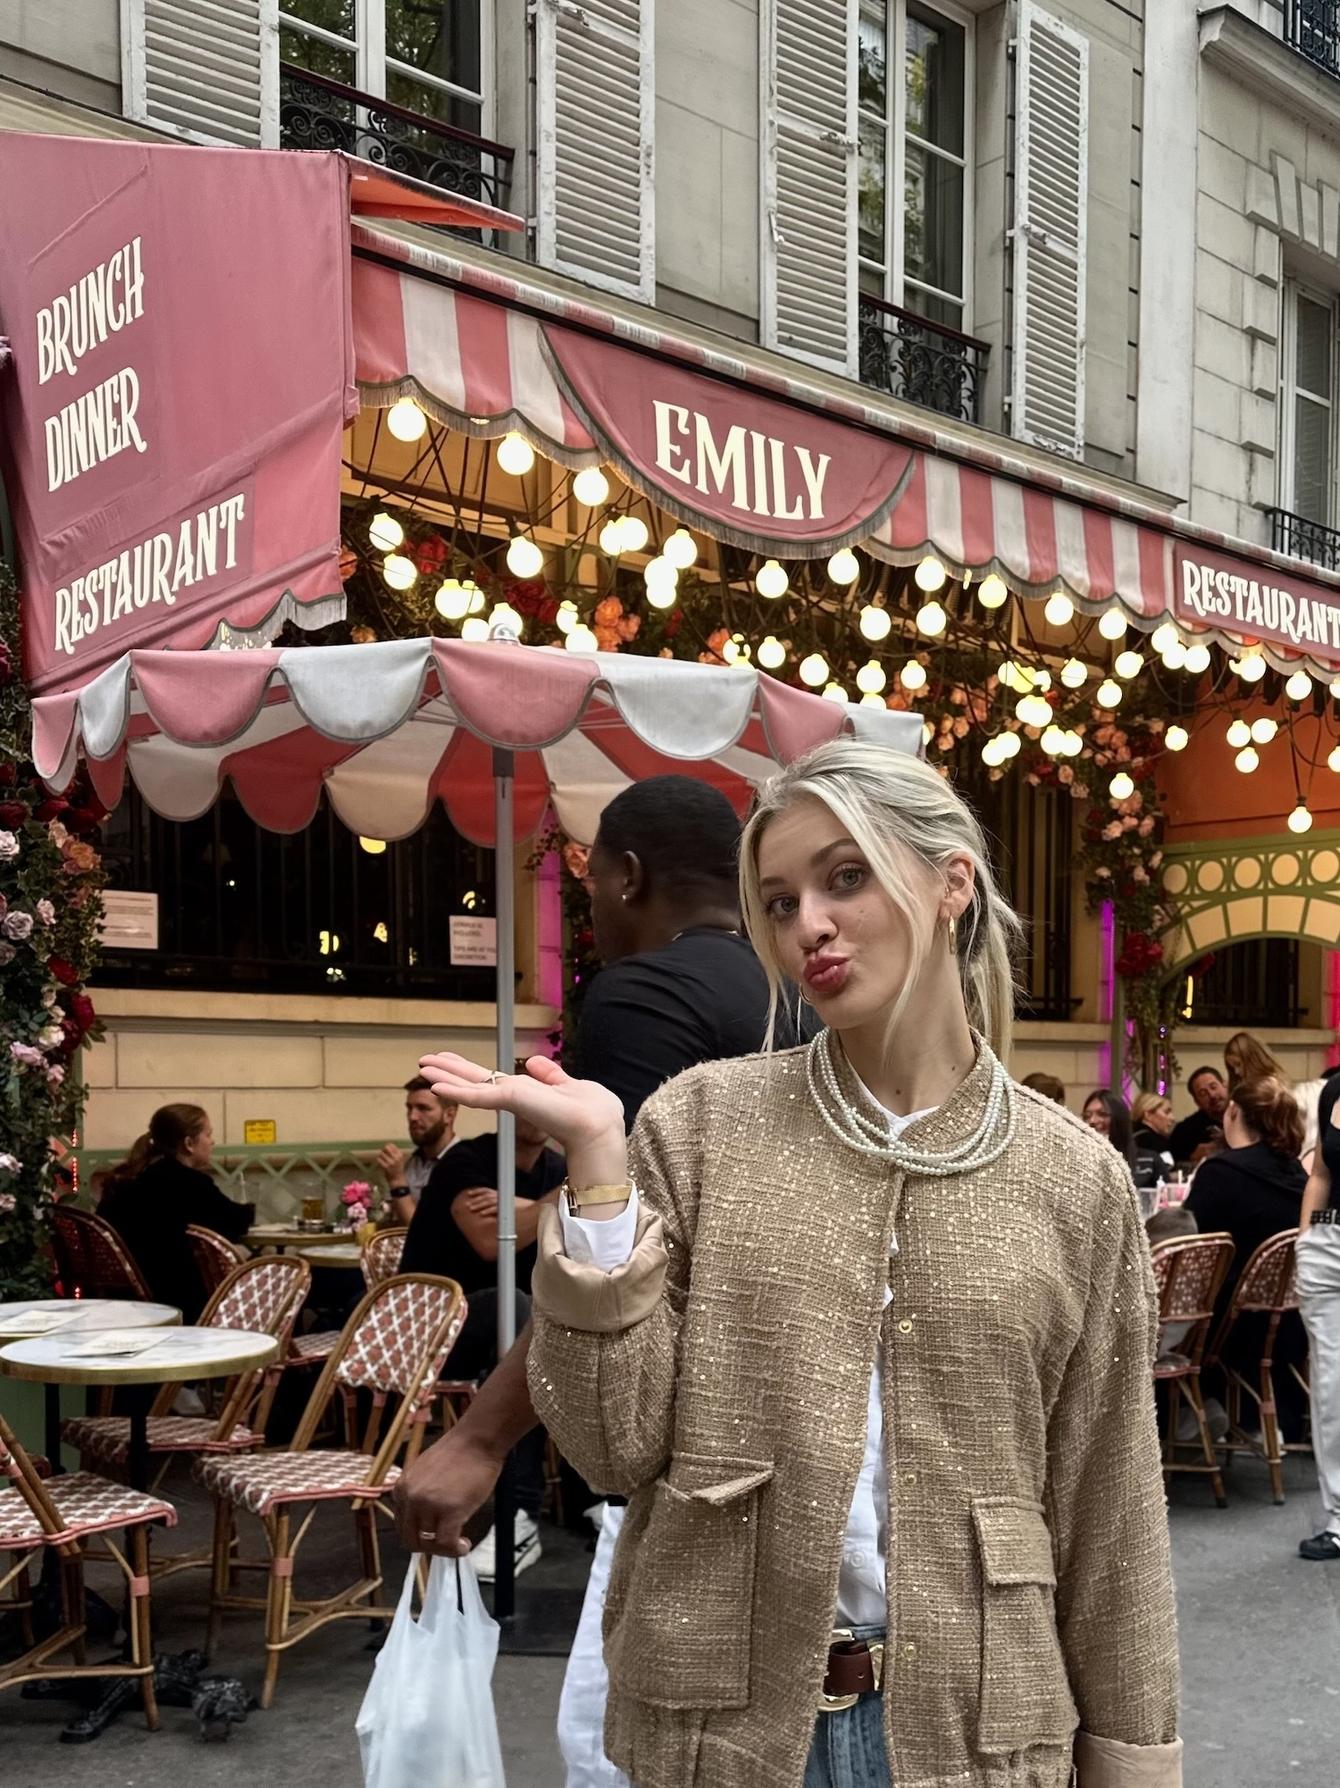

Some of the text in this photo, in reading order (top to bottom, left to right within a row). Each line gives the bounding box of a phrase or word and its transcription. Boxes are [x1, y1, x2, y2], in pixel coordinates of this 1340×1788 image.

[36, 236, 145, 385] BRUNCH
[44, 366, 147, 492] DINNER
[652, 399, 832, 520] EMILY
[54, 493, 245, 655] RESTAURANT
[1182, 559, 1340, 649] RESTAURANT
